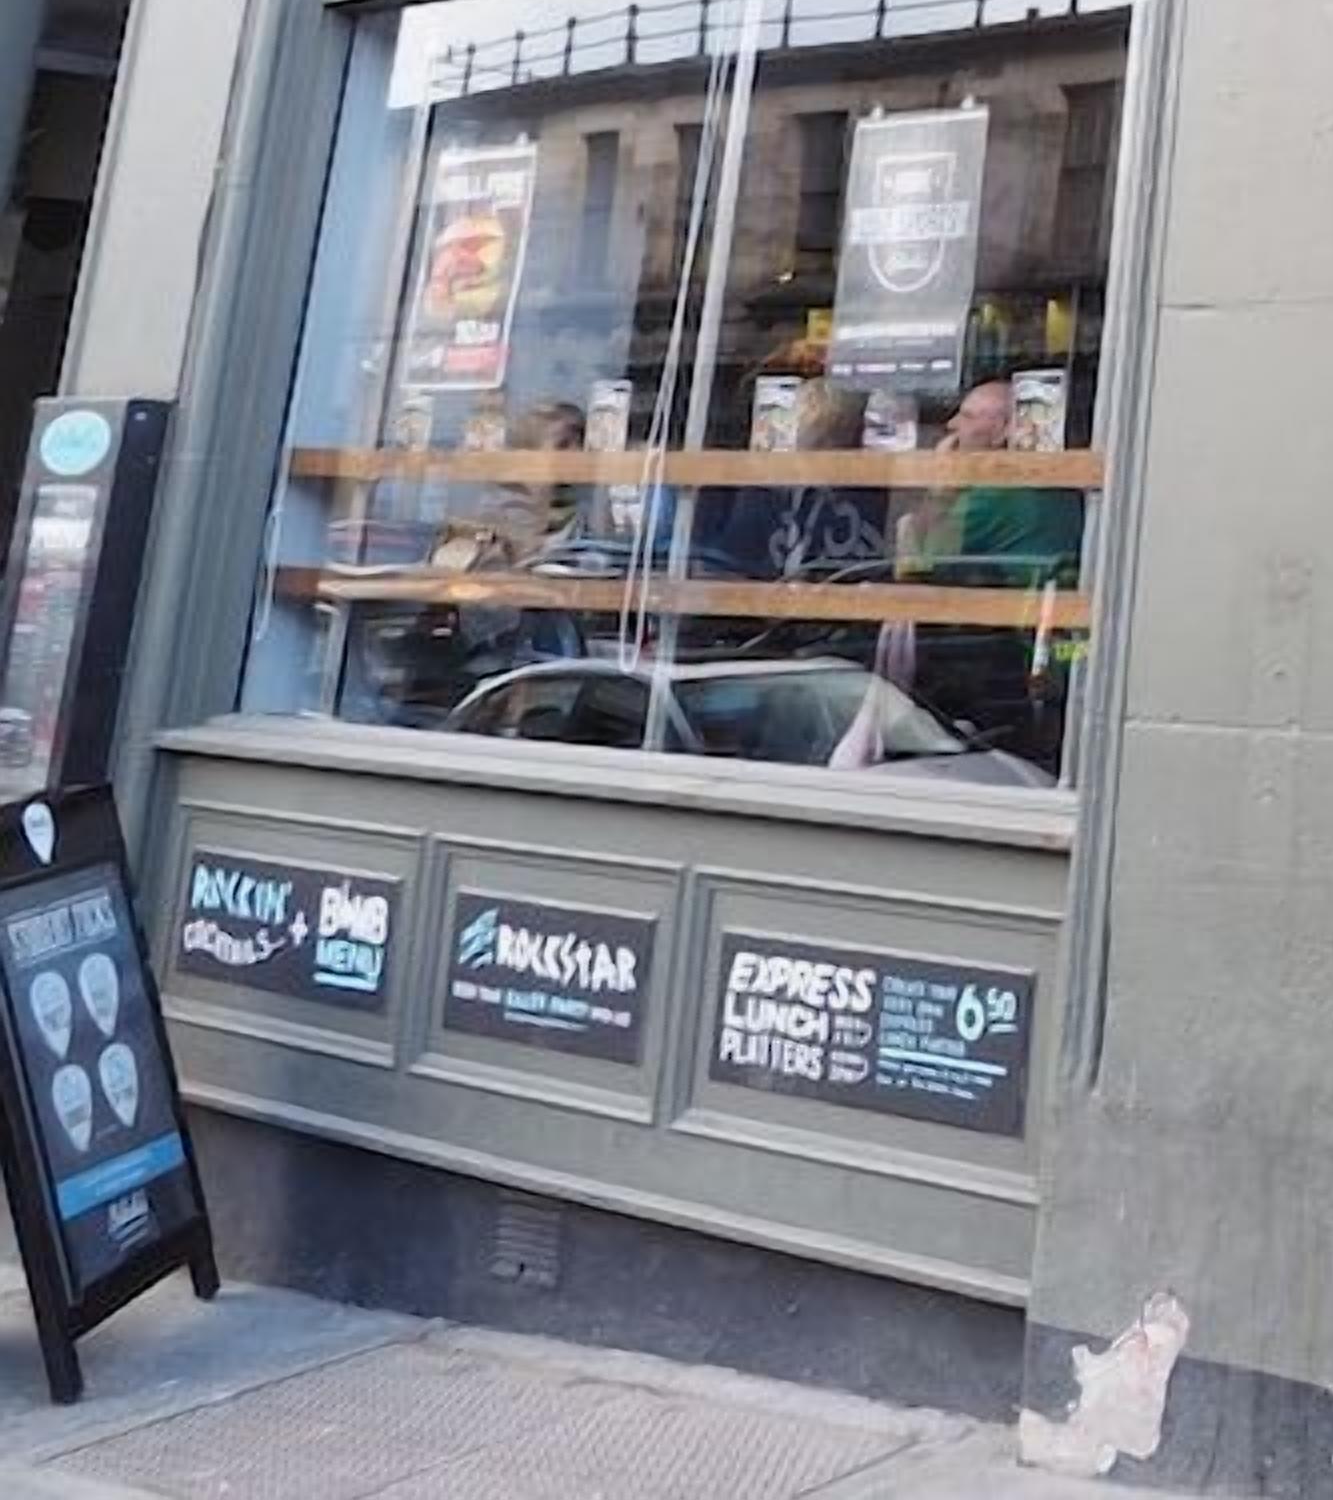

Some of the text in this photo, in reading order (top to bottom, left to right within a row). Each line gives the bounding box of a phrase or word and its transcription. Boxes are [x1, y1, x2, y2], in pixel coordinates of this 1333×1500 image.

[496, 924, 637, 992] ROCKSTAR
[728, 952, 876, 1012] EXPRESS
[724, 992, 829, 1042] LUNCH
